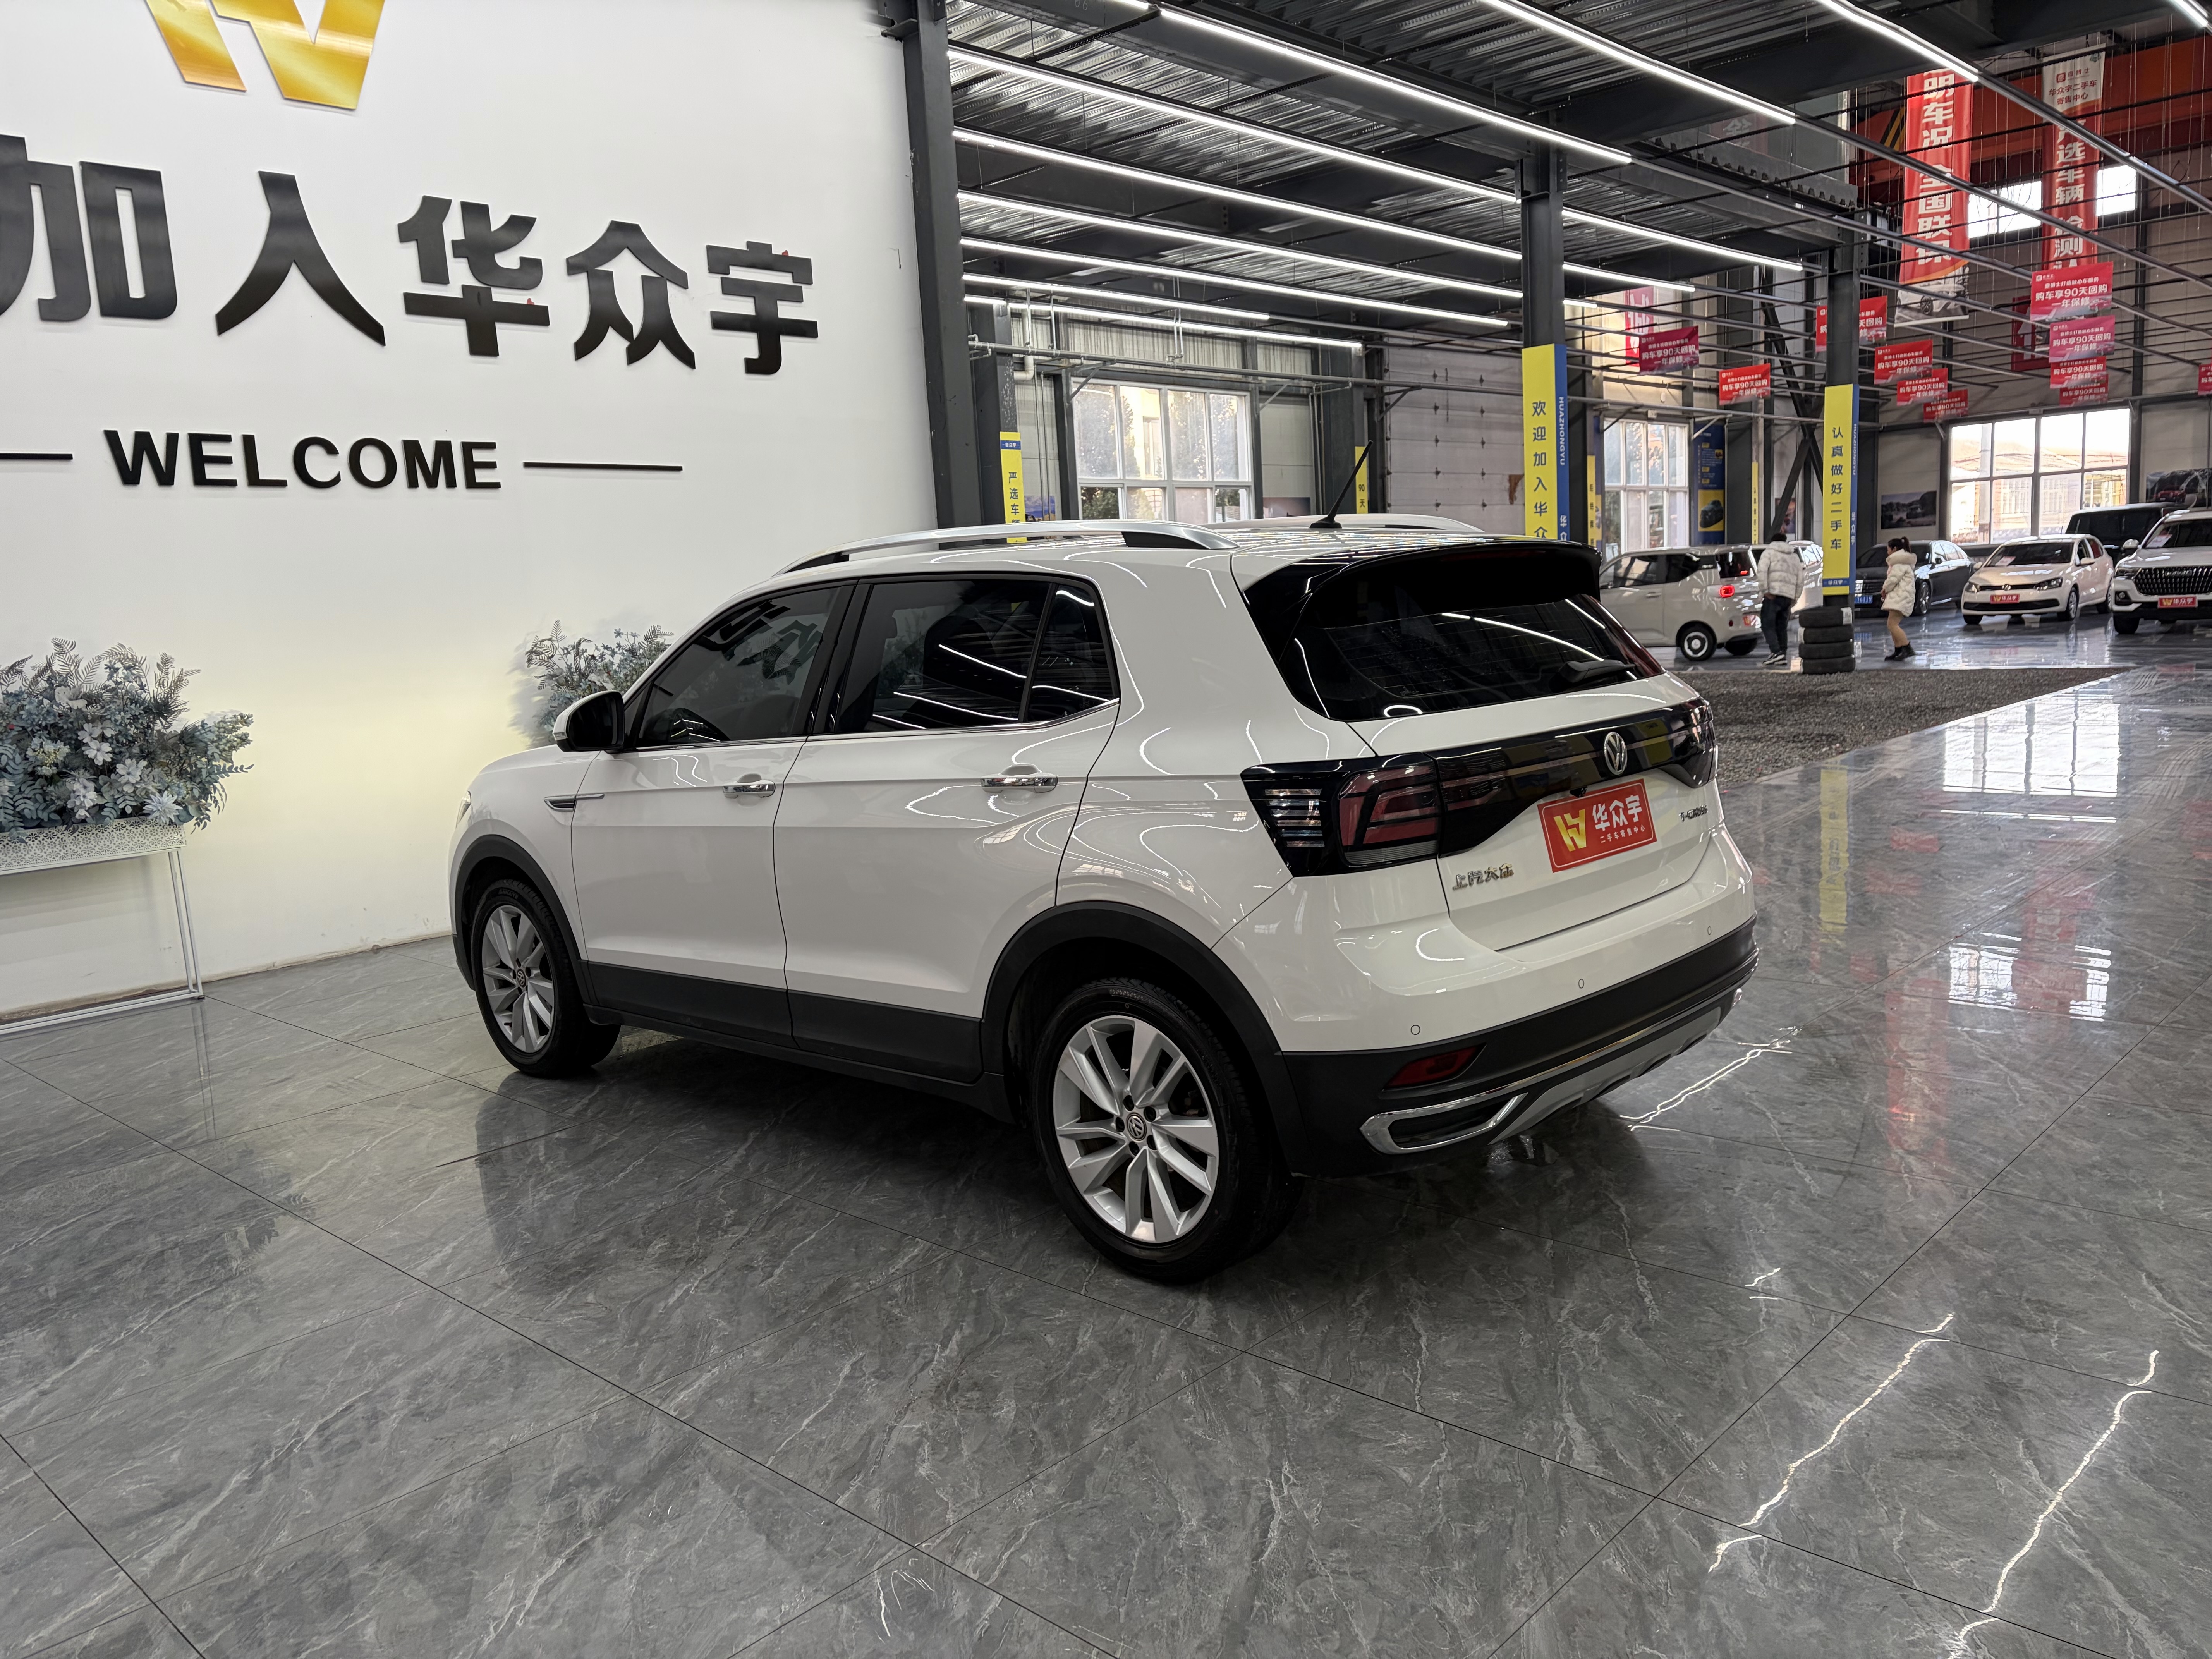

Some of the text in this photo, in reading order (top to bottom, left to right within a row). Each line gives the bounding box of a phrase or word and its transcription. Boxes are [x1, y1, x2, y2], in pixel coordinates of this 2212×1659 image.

[2049, 80, 2097, 96] 华众宇二手车
[2057, 92, 2088, 105] 寄售中心
[1922, 68, 1954, 149] 明车况
[0, 134, 818, 375] 加入华众宇
[2035, 284, 2108, 301] 购车享90天回购
[2052, 297, 2091, 307] 一年保修
[2053, 333, 2111, 347] 购车享90天回购
[2066, 342, 2097, 352] 一年保修
[1642, 345, 1696, 360] 购车享90天回购
[1654, 355, 1683, 365] 一年保修
[1878, 356, 1929, 369] 购车享90天回购
[103, 429, 502, 490] WELCOME
[1831, 426, 1843, 550] 认真做好二手车
[1592, 795, 1642, 831] 华众宇
[1600, 824, 1645, 843] 二手车寄售中心
[1452, 863, 1514, 891] 上汽大众
